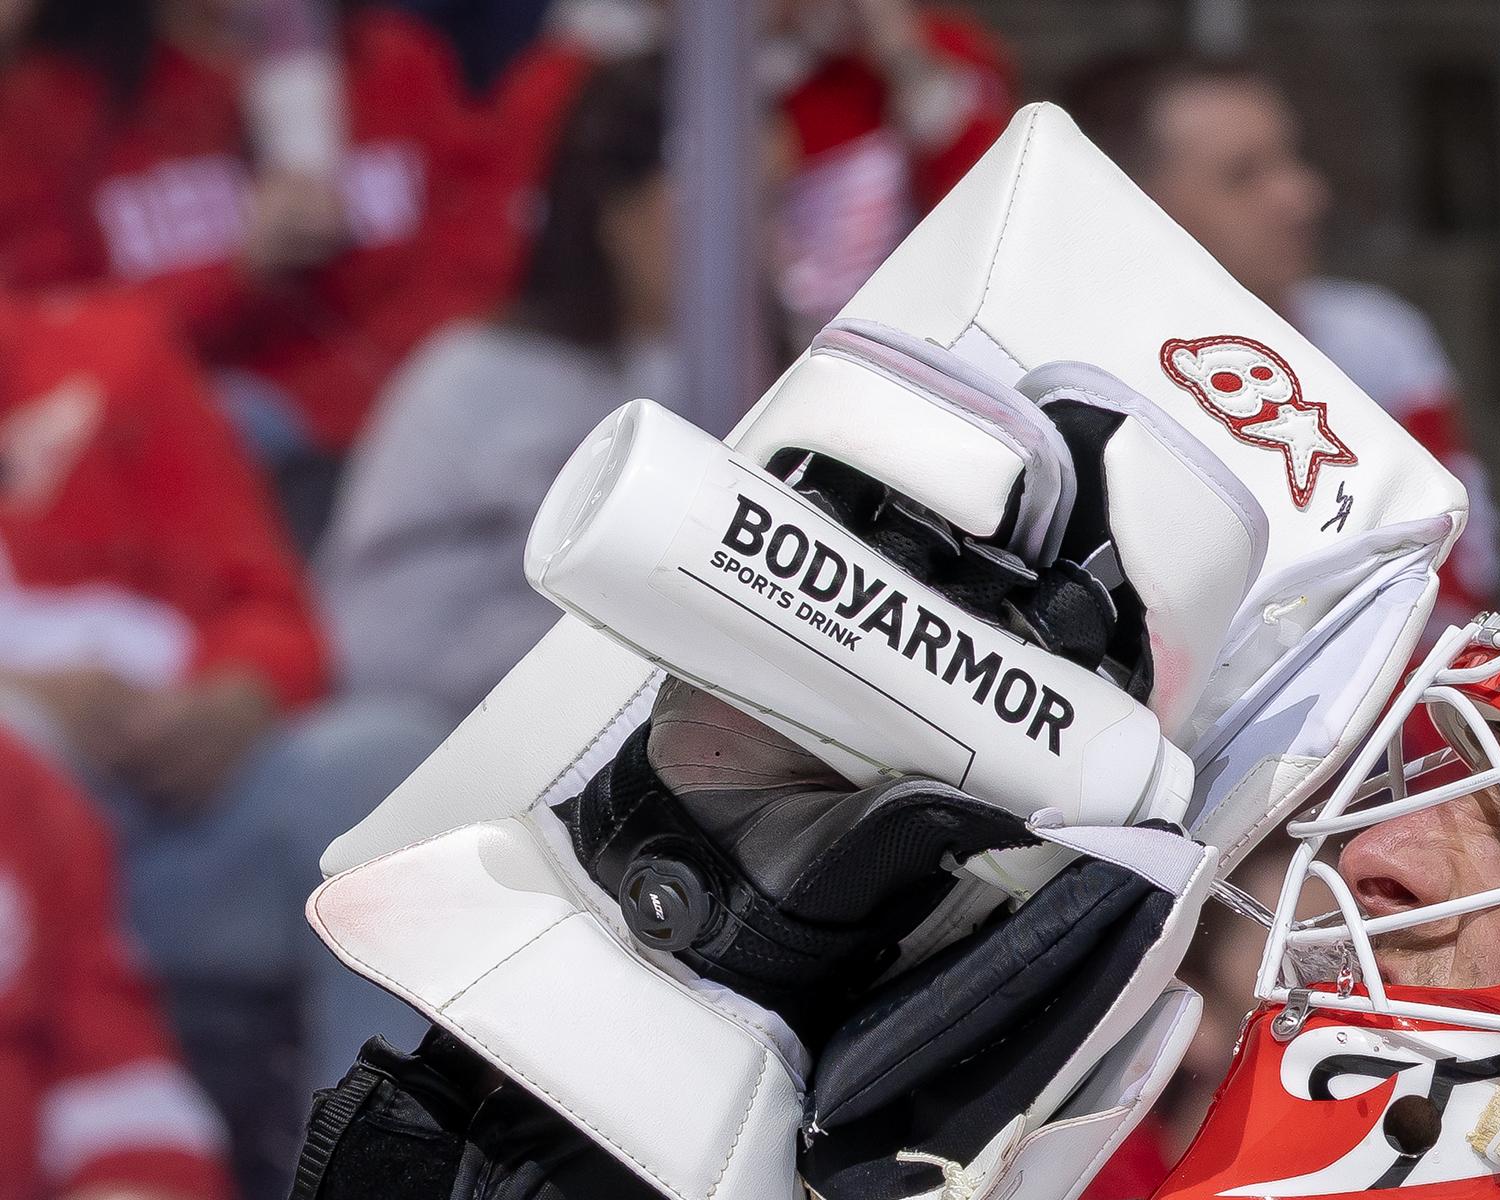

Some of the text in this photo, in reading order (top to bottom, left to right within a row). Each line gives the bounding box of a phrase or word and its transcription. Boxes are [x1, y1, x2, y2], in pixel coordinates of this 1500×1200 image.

[709, 550, 863, 652] SPORTS DRINK
[720, 492, 1075, 757] BODYARMOR
